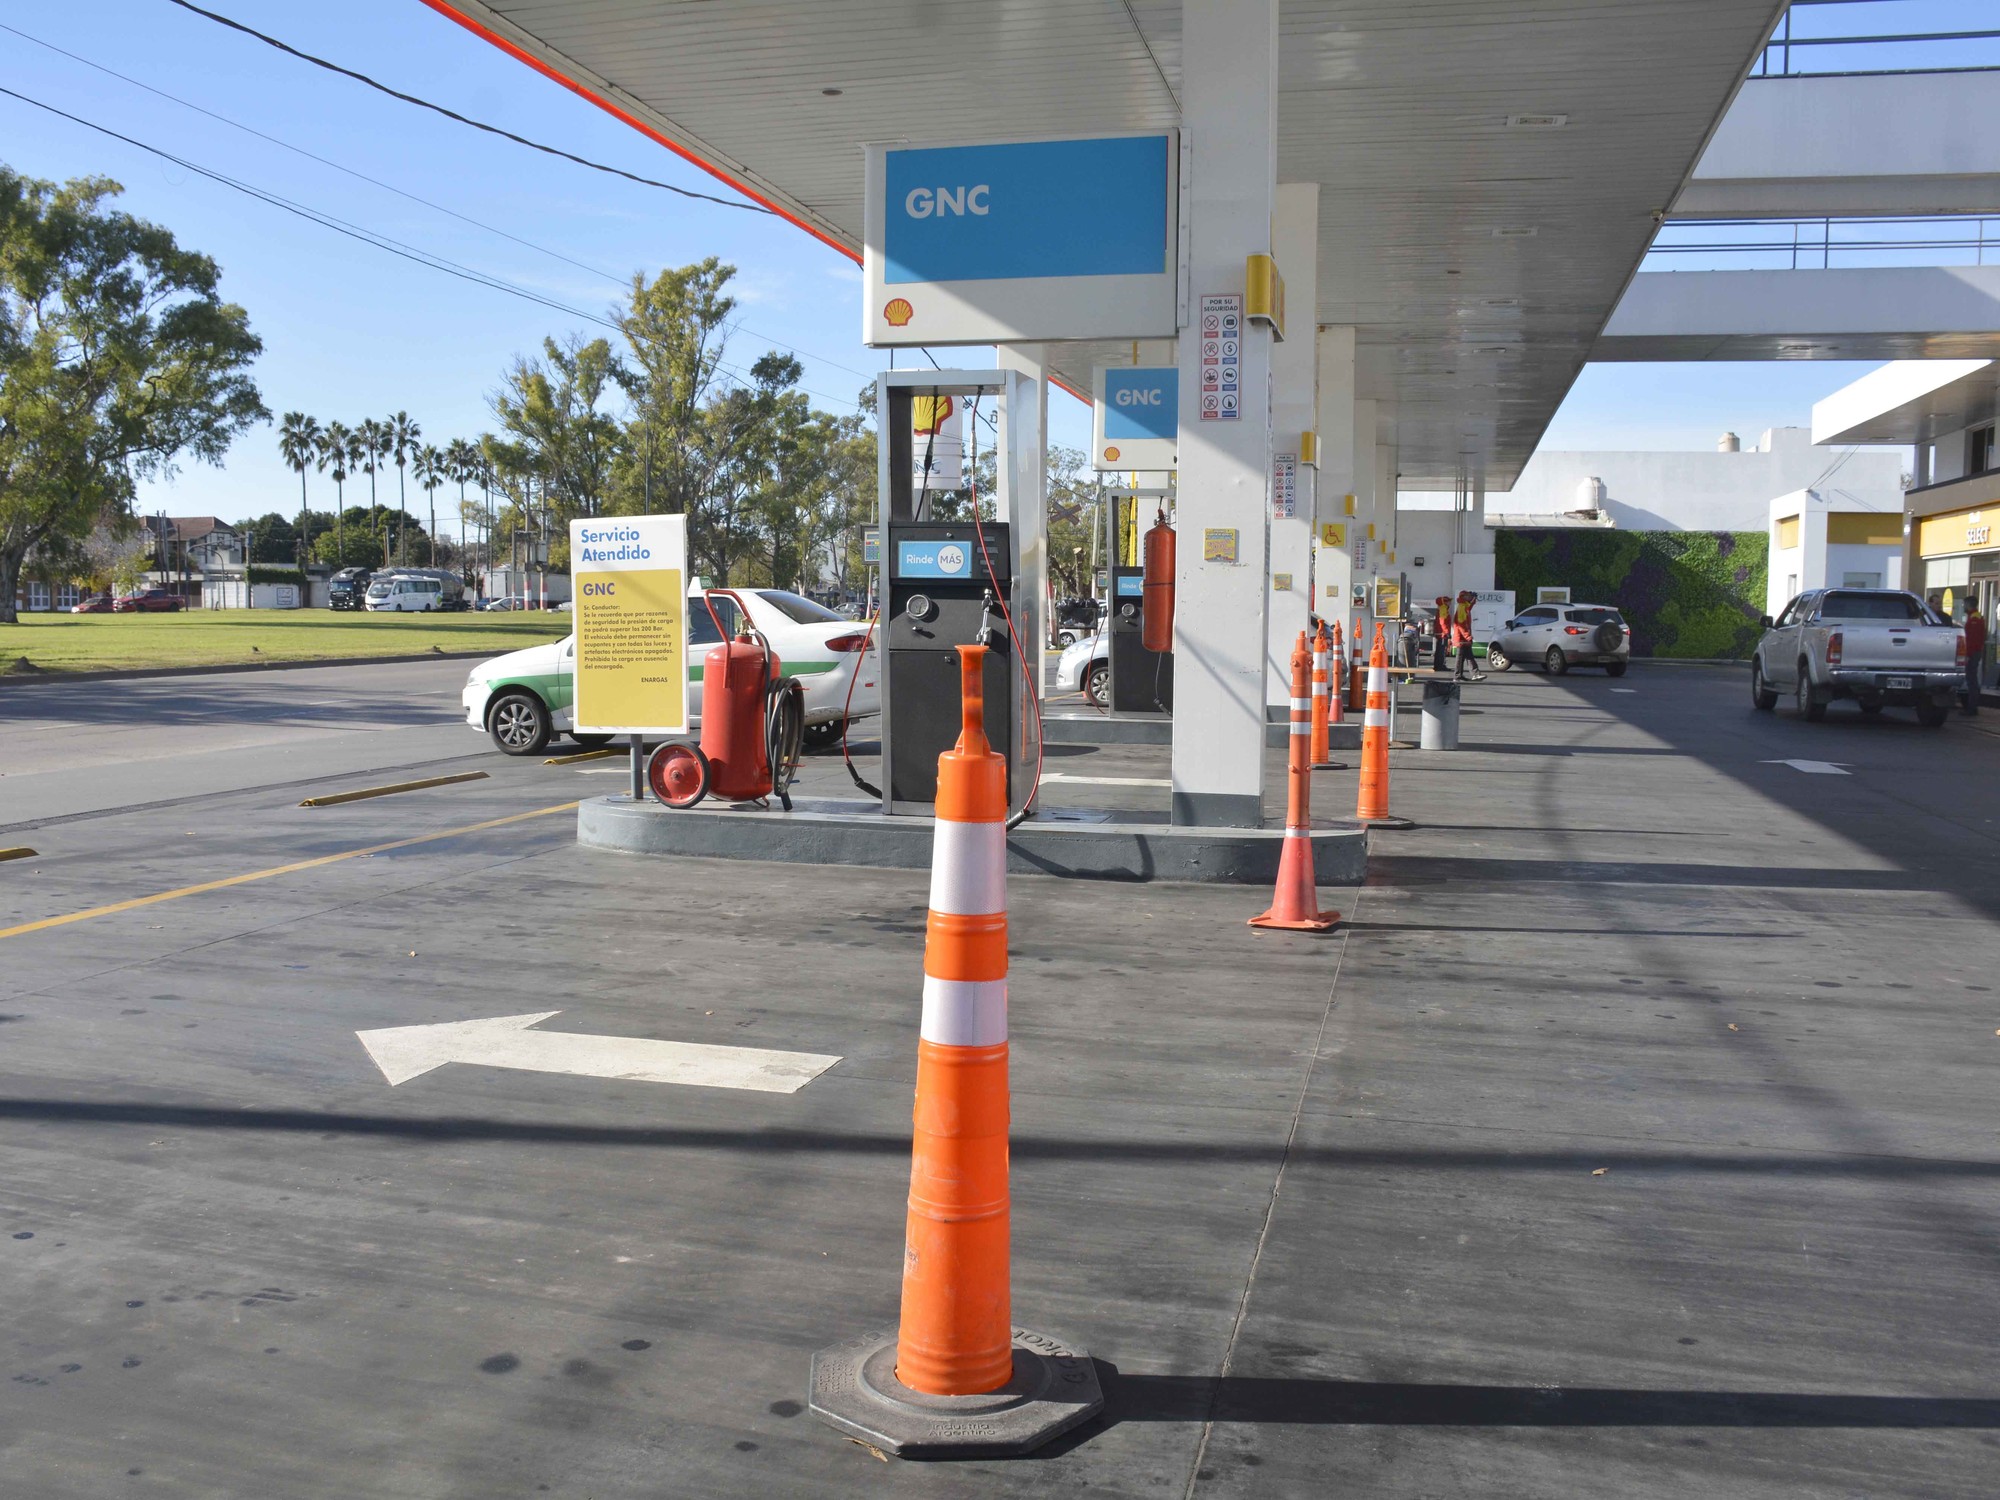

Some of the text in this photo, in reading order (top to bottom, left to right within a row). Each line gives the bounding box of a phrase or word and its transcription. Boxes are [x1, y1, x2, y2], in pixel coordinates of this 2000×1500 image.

[905, 184, 989, 219] GNC
[1115, 388, 1161, 406] GNC
[581, 526, 640, 543] Servicio
[581, 544, 651, 562] Atendido
[906, 553, 962, 564] Rinde MÁS
[583, 582, 615, 596] GNC
[932, 1422, 989, 1430] Industria
